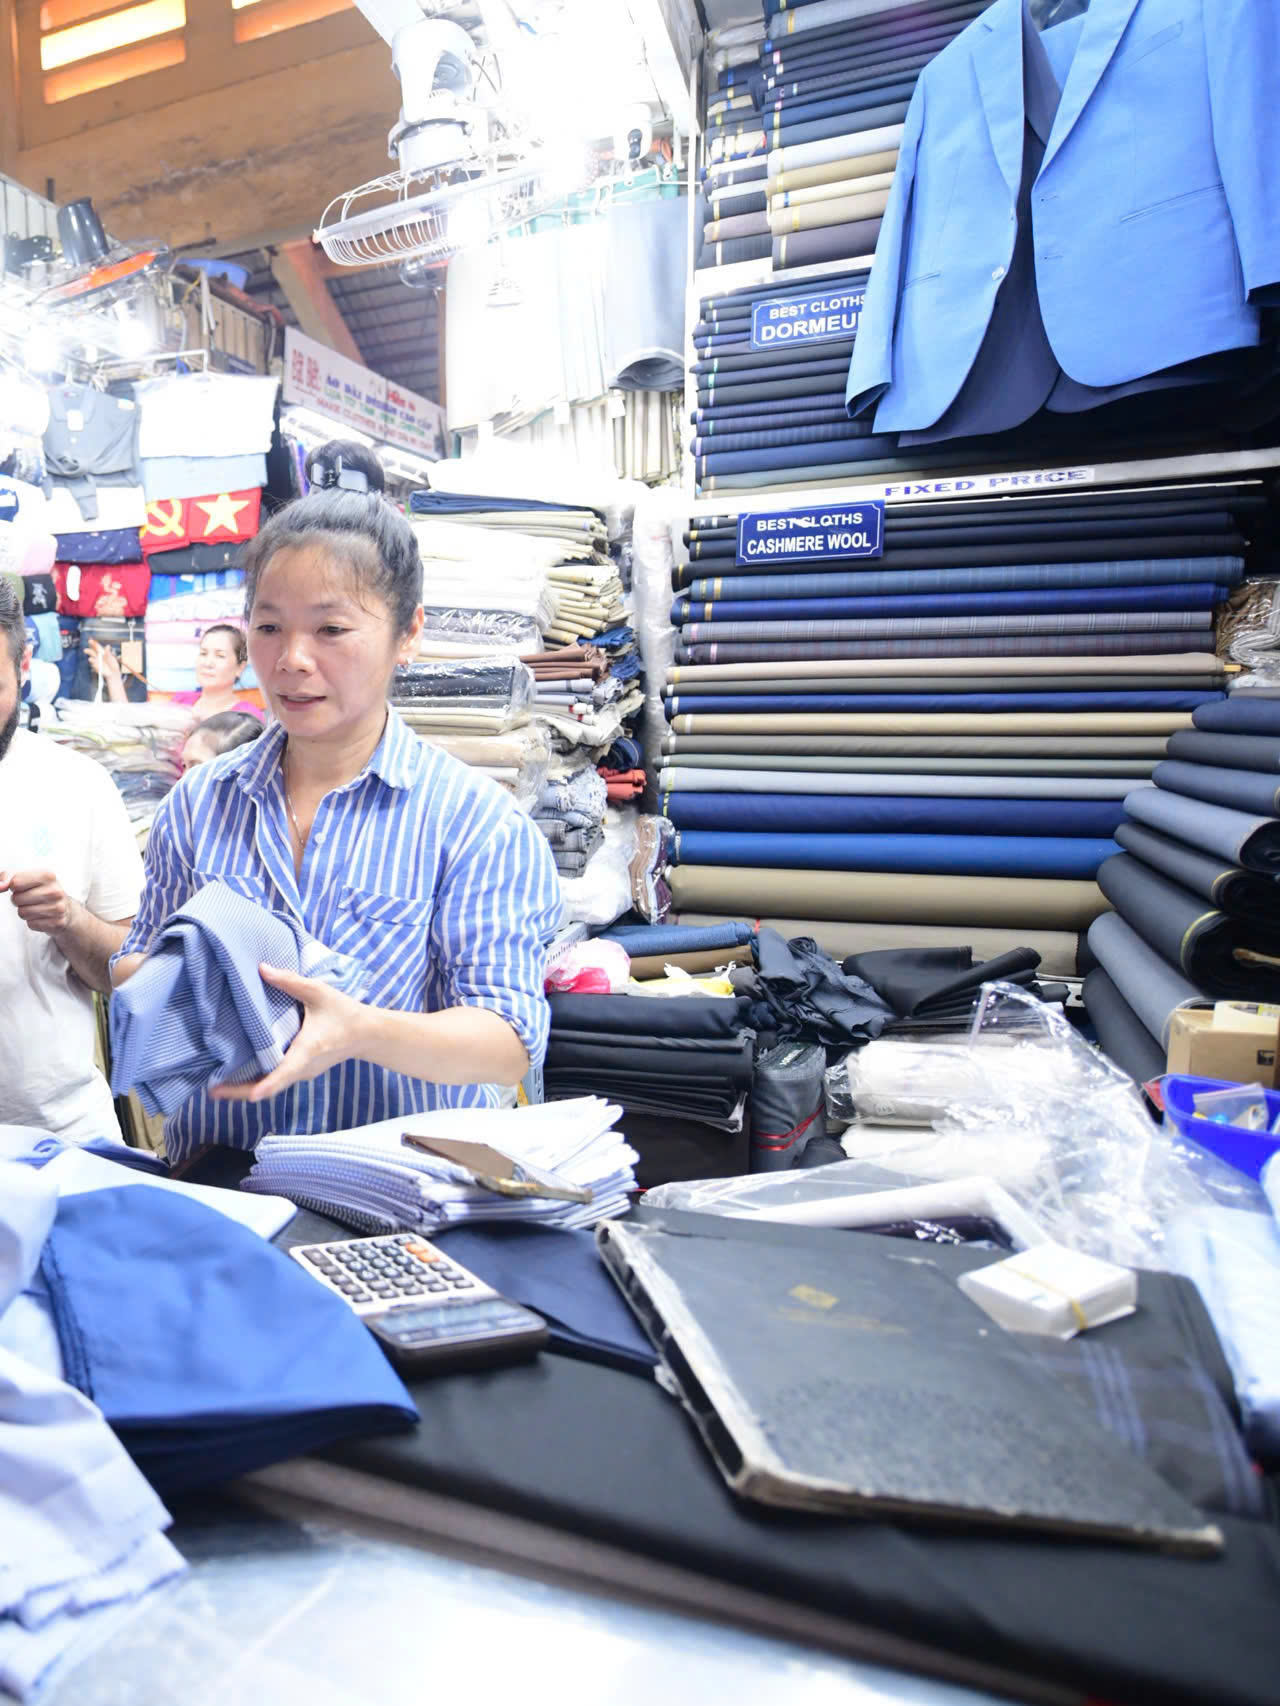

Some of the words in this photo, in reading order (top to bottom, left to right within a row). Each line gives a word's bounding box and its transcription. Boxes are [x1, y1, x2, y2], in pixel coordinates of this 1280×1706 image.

[769, 303, 807, 319] BEST
[885, 480, 975, 496] FIXED
[989, 470, 1088, 488] PRICE
[756, 518, 795, 531] BEST
[747, 535, 824, 555] CASHMERE
[827, 532, 871, 549] WOOL
